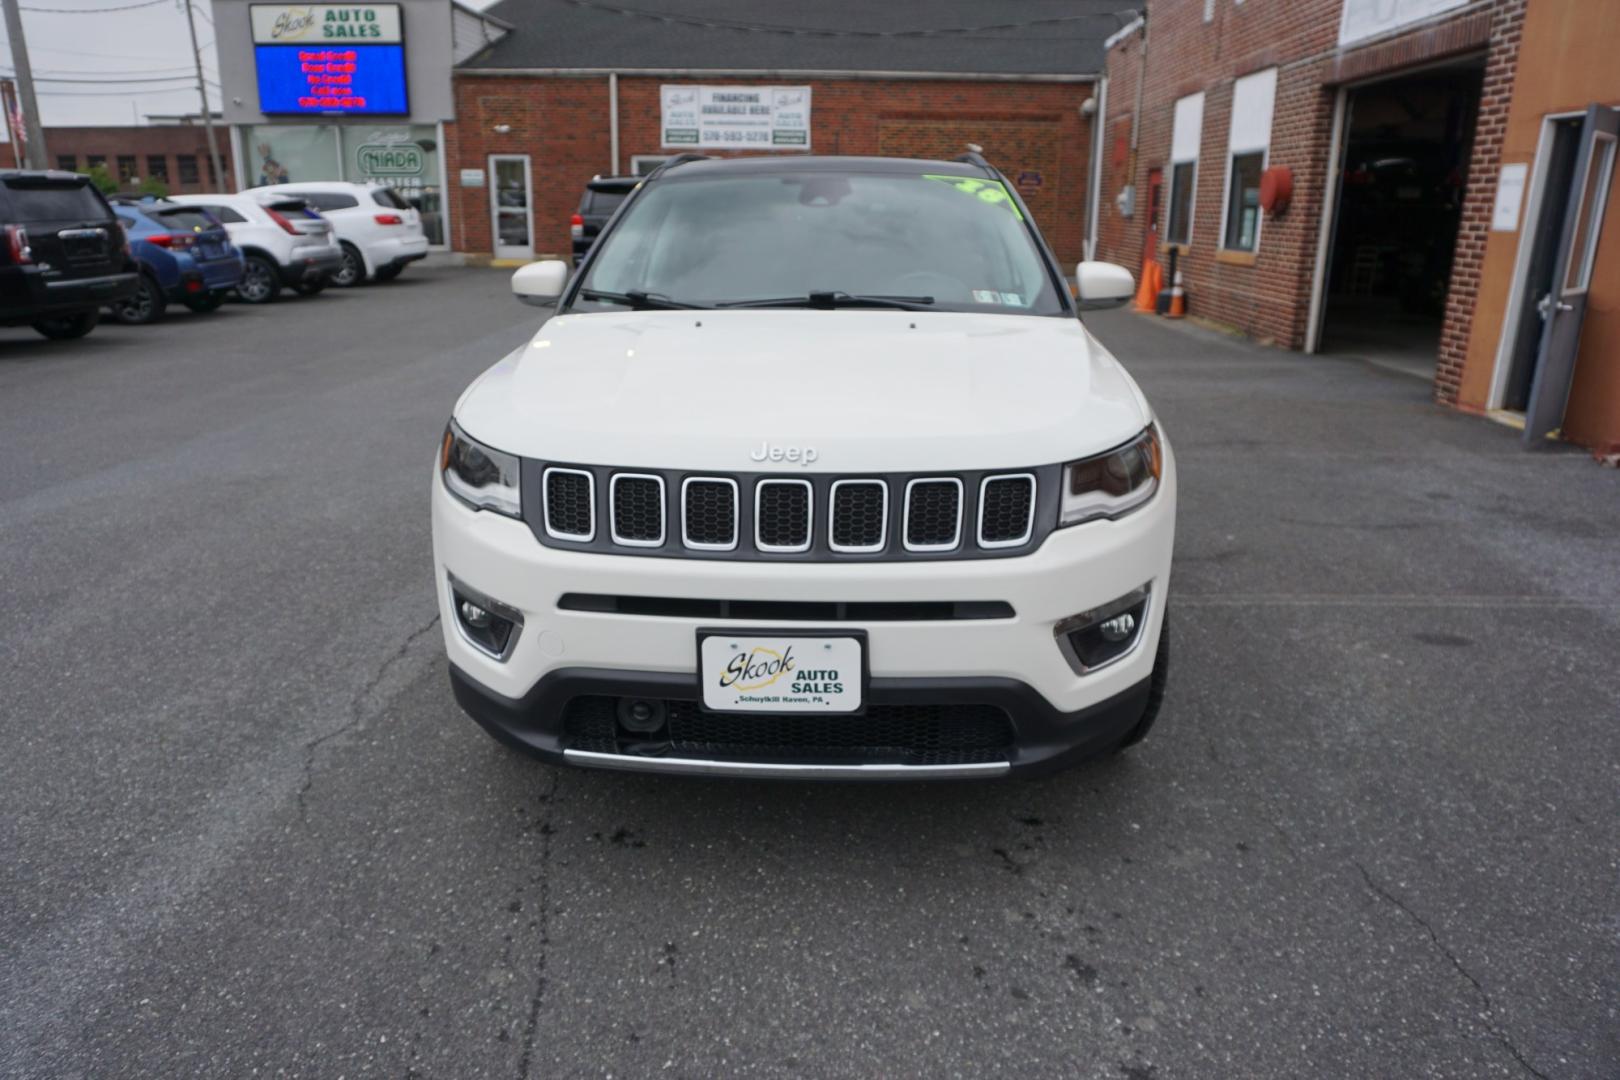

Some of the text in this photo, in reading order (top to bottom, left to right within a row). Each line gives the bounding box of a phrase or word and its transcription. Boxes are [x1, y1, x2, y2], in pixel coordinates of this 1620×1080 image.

[325, 9, 375, 22] AUTO
[272, 7, 315, 38] Skook
[323, 24, 381, 37] SALES
[363, 151, 418, 168] NIADA
[751, 440, 818, 466] Jeep
[719, 645, 794, 687] Skook
[796, 670, 839, 681] AUTO
[791, 682, 844, 694] SALES
[739, 695, 780, 704] Schuylkill
